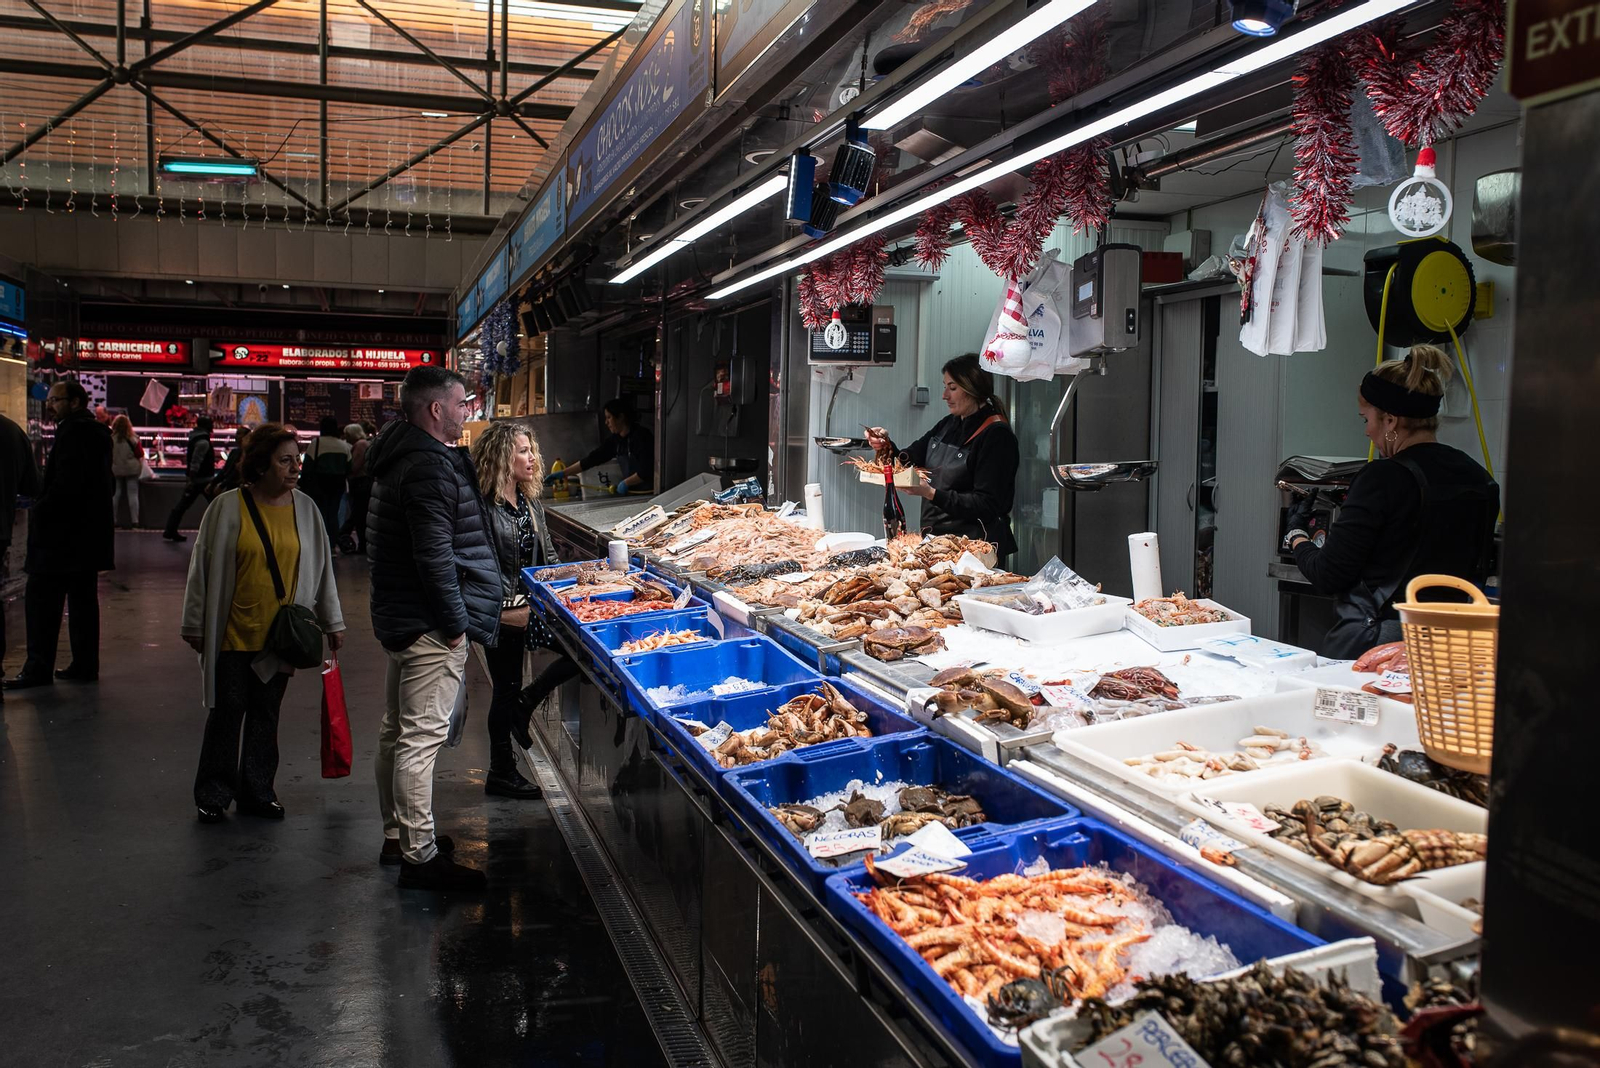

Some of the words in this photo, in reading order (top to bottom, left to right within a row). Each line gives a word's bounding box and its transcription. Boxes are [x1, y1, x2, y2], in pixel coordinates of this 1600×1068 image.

[597, 84, 634, 162] CHOCOS
[1028, 328, 1045, 338] LVA
[97, 342, 163, 354] CARNICERÍA
[282, 347, 348, 358] ELABORADOS
[350, 350, 363, 359] LA
[365, 350, 406, 360] HIJUELA
[98, 352, 112, 360] tipo
[256, 354, 268, 363] 22
